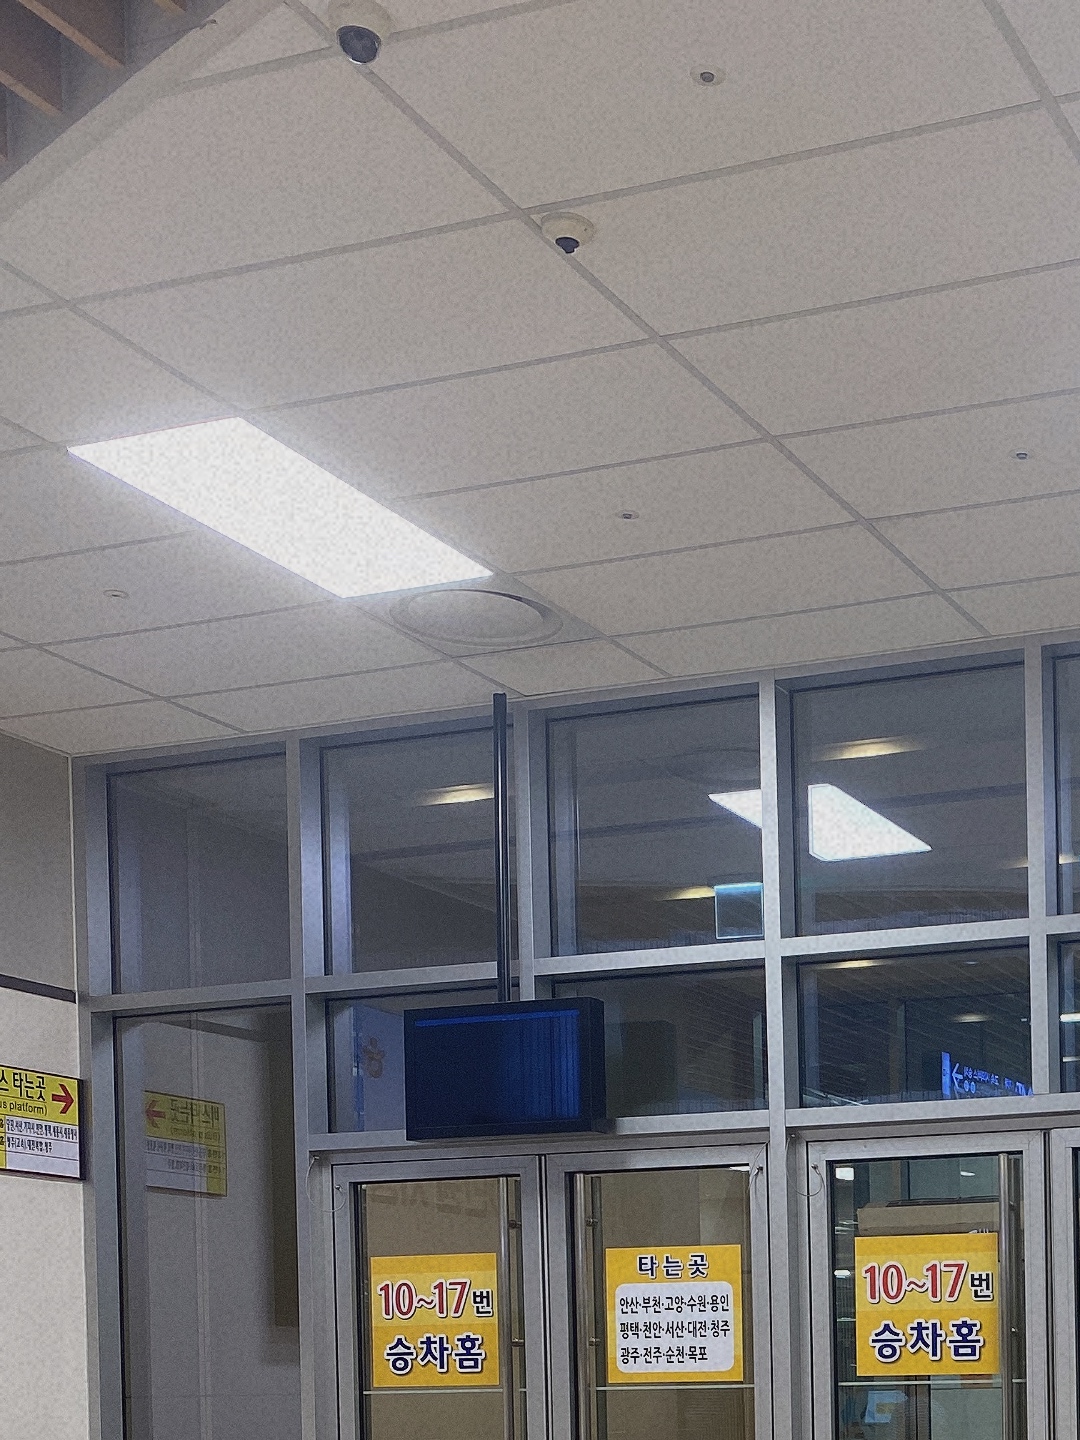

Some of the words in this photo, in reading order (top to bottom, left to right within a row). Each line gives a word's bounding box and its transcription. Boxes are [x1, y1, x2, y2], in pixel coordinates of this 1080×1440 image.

[13, 1072, 46, 1101] 타는곳
[378, 1278, 494, 1320] 10~17번
[862, 1260, 994, 1303] 10~17번
[385, 1334, 486, 1375] 승차홈
[869, 1318, 984, 1362] 승차홈
